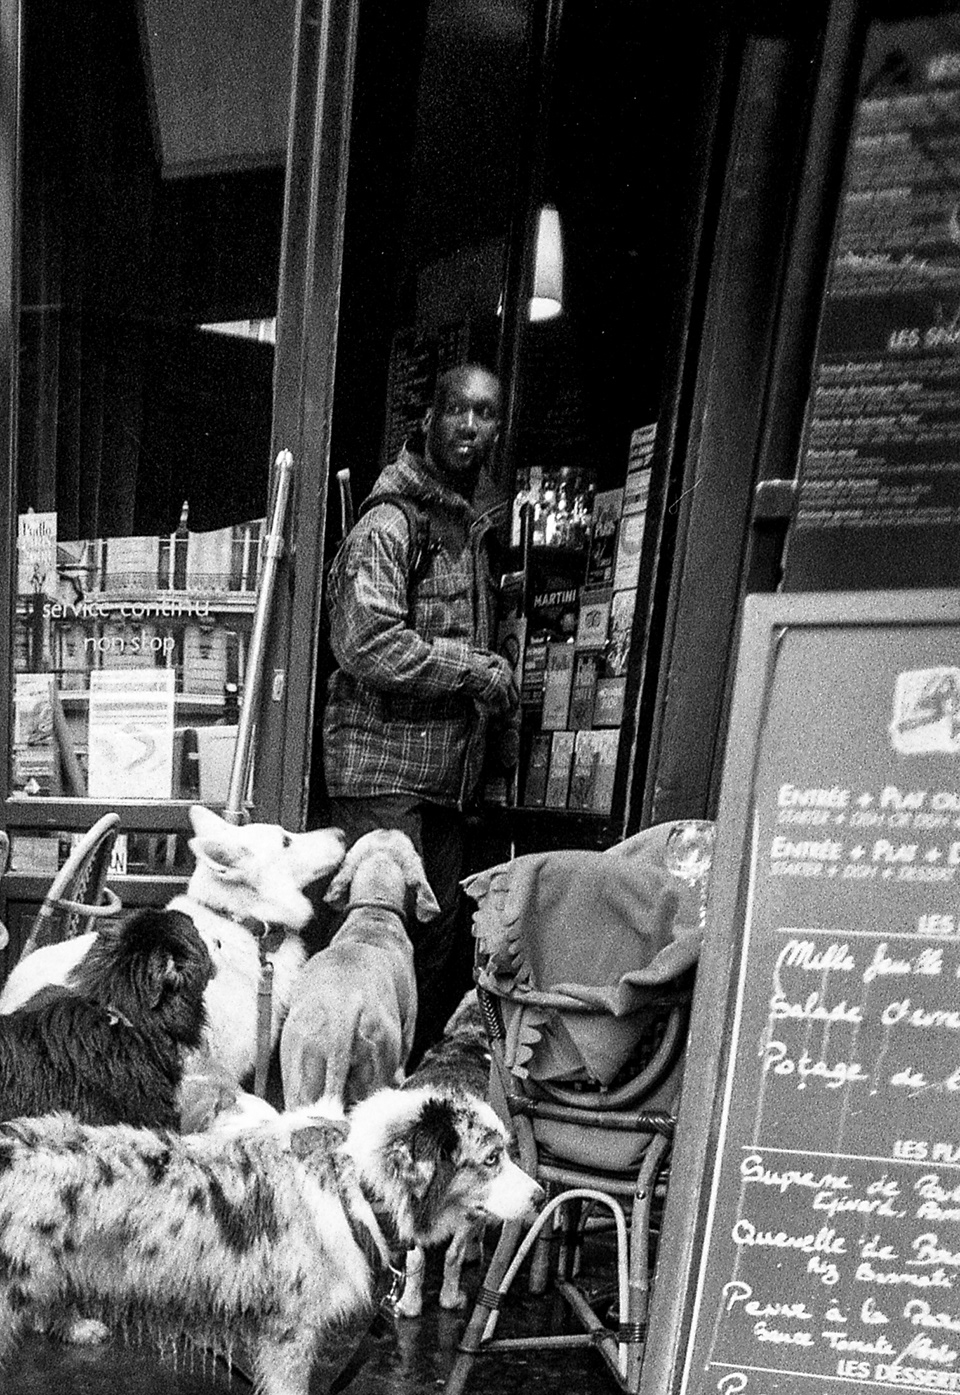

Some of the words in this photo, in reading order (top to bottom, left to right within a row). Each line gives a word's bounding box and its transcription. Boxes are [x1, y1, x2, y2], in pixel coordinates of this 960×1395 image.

[42, 600, 110, 619] service
[120, 598, 210, 618] continu
[534, 589, 577, 608] MARTINI
[84, 635, 125, 651] non
[130, 628, 176, 657] stop
[880, 786, 928, 810] PLAT
[872, 838, 919, 863] PLAT
[916, 913, 956, 934] LES
[770, 992, 864, 1023] Salade
[762, 1040, 869, 1089] Potage
[893, 1140, 929, 1160] LES
[837, 1358, 871, 1379] LES
